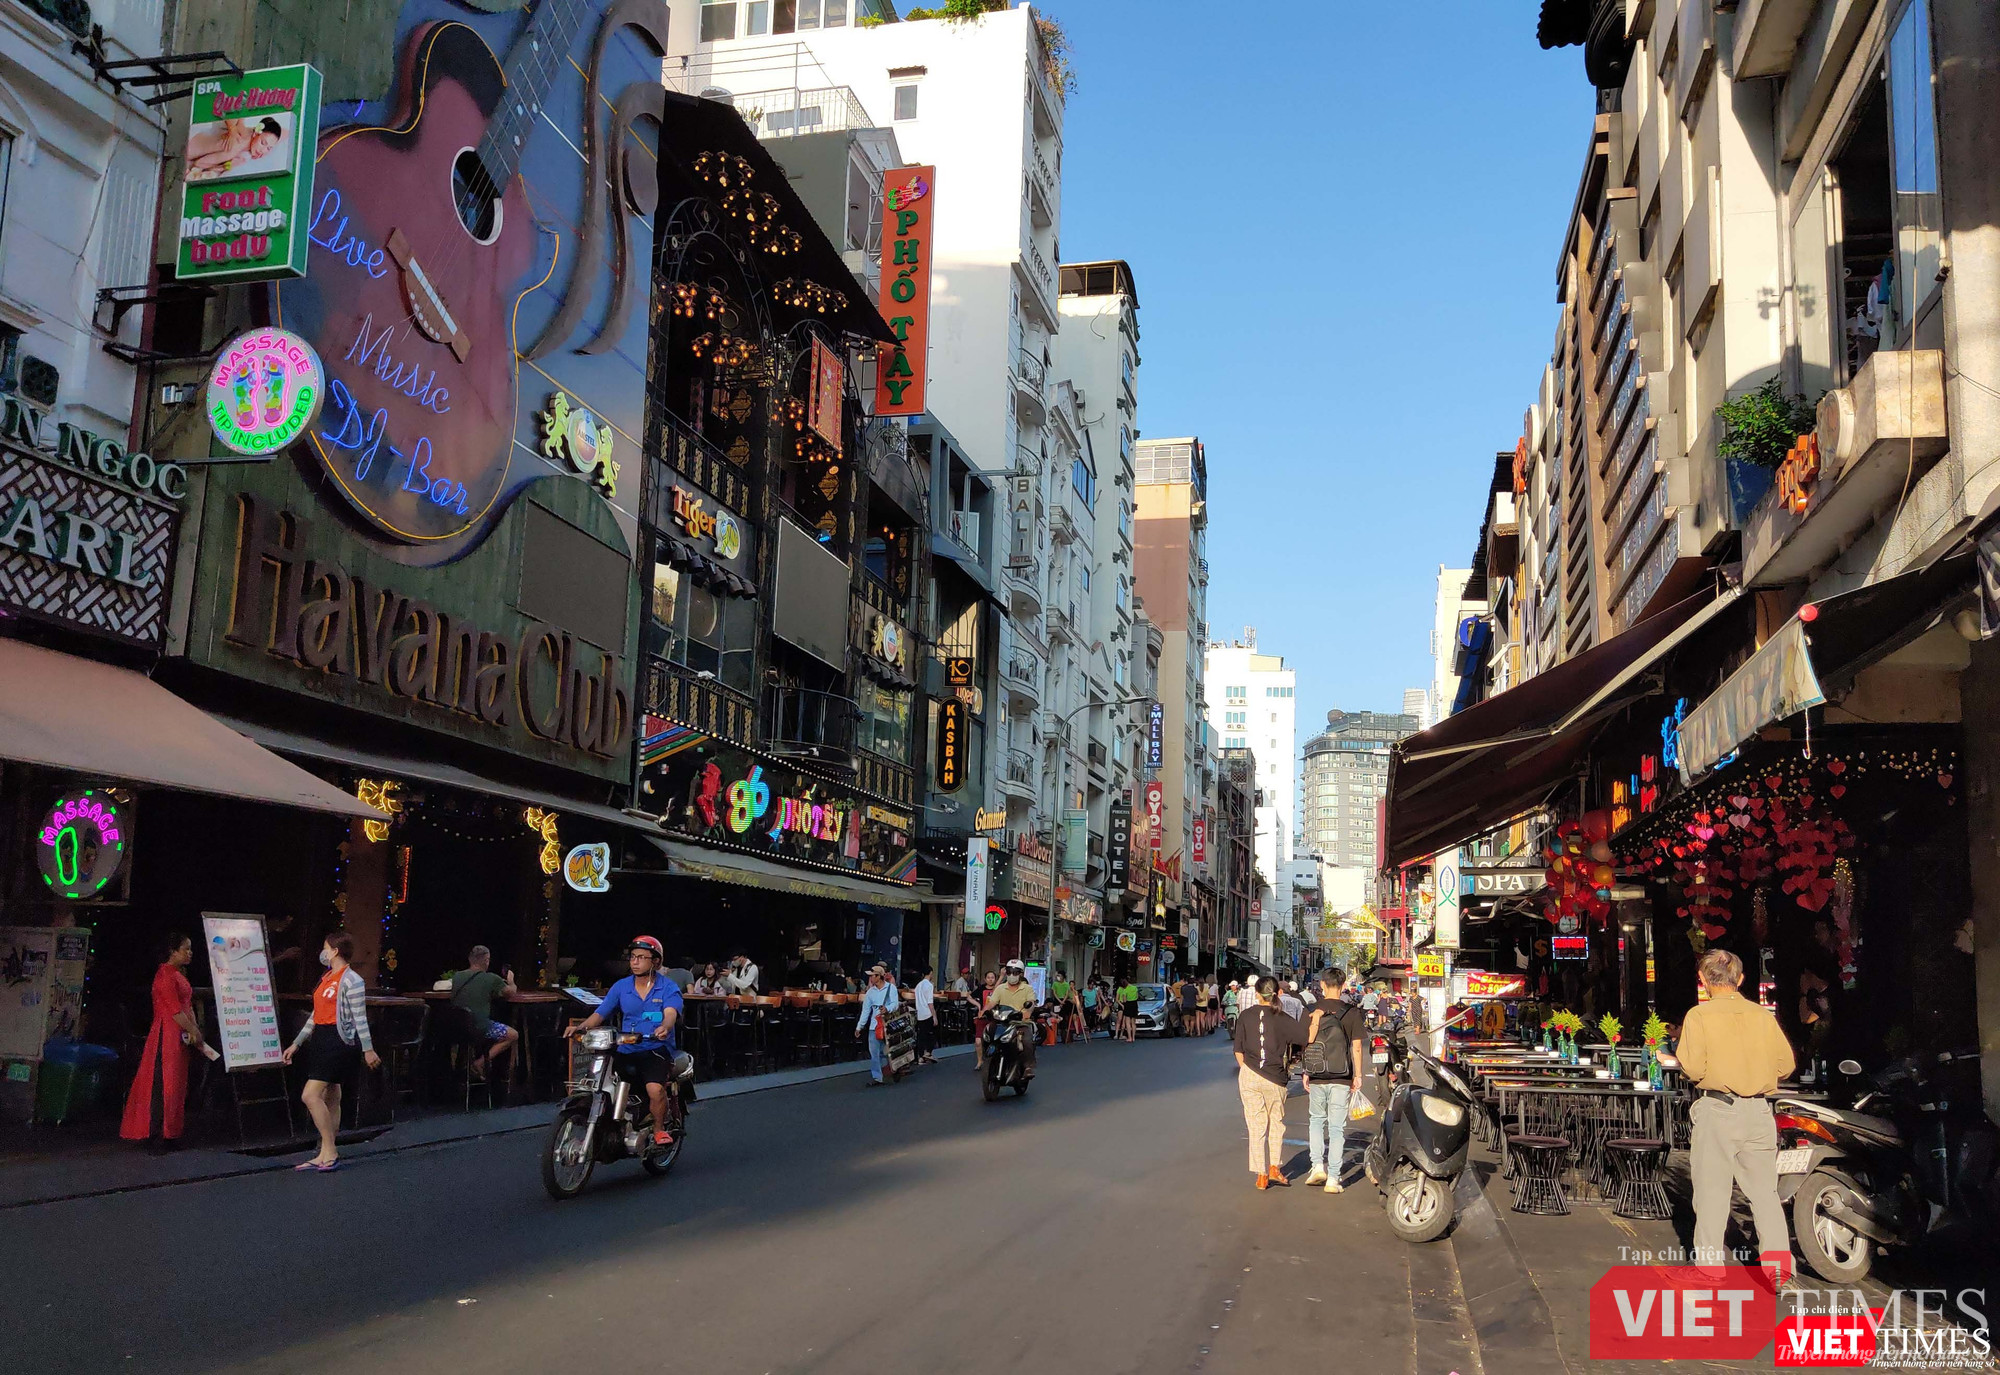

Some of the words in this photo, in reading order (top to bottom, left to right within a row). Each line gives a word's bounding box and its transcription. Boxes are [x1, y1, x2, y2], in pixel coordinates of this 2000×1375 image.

[197, 81, 222, 95] SPA
[202, 185, 271, 213] Foot
[190, 234, 268, 263] body
[307, 189, 387, 278] Live
[214, 333, 312, 388] MASSAGE
[344, 312, 450, 414] Music
[211, 400, 233, 432] TIP
[230, 385, 314, 450] INCLUDED
[672, 484, 717, 538] Tiger
[1015, 480, 1030, 552] BALI
[1151, 704, 1162, 739] SMALL
[944, 704, 956, 784] KASBAH
[1151, 741, 1161, 762] BAY
[725, 765, 769, 833] 86
[1149, 790, 1161, 826] OYO
[41, 798, 119, 847] MASSAGE
[1195, 826, 1203, 851] OYO
[1112, 819, 1127, 884] HOTEL
[1478, 861, 1526, 891] SPA
[1088, 935, 1100, 945] 24
[1423, 964, 1440, 974] 4G
[225, 1017, 251, 1026] Manicure
[231, 1051, 257, 1062] Designer
